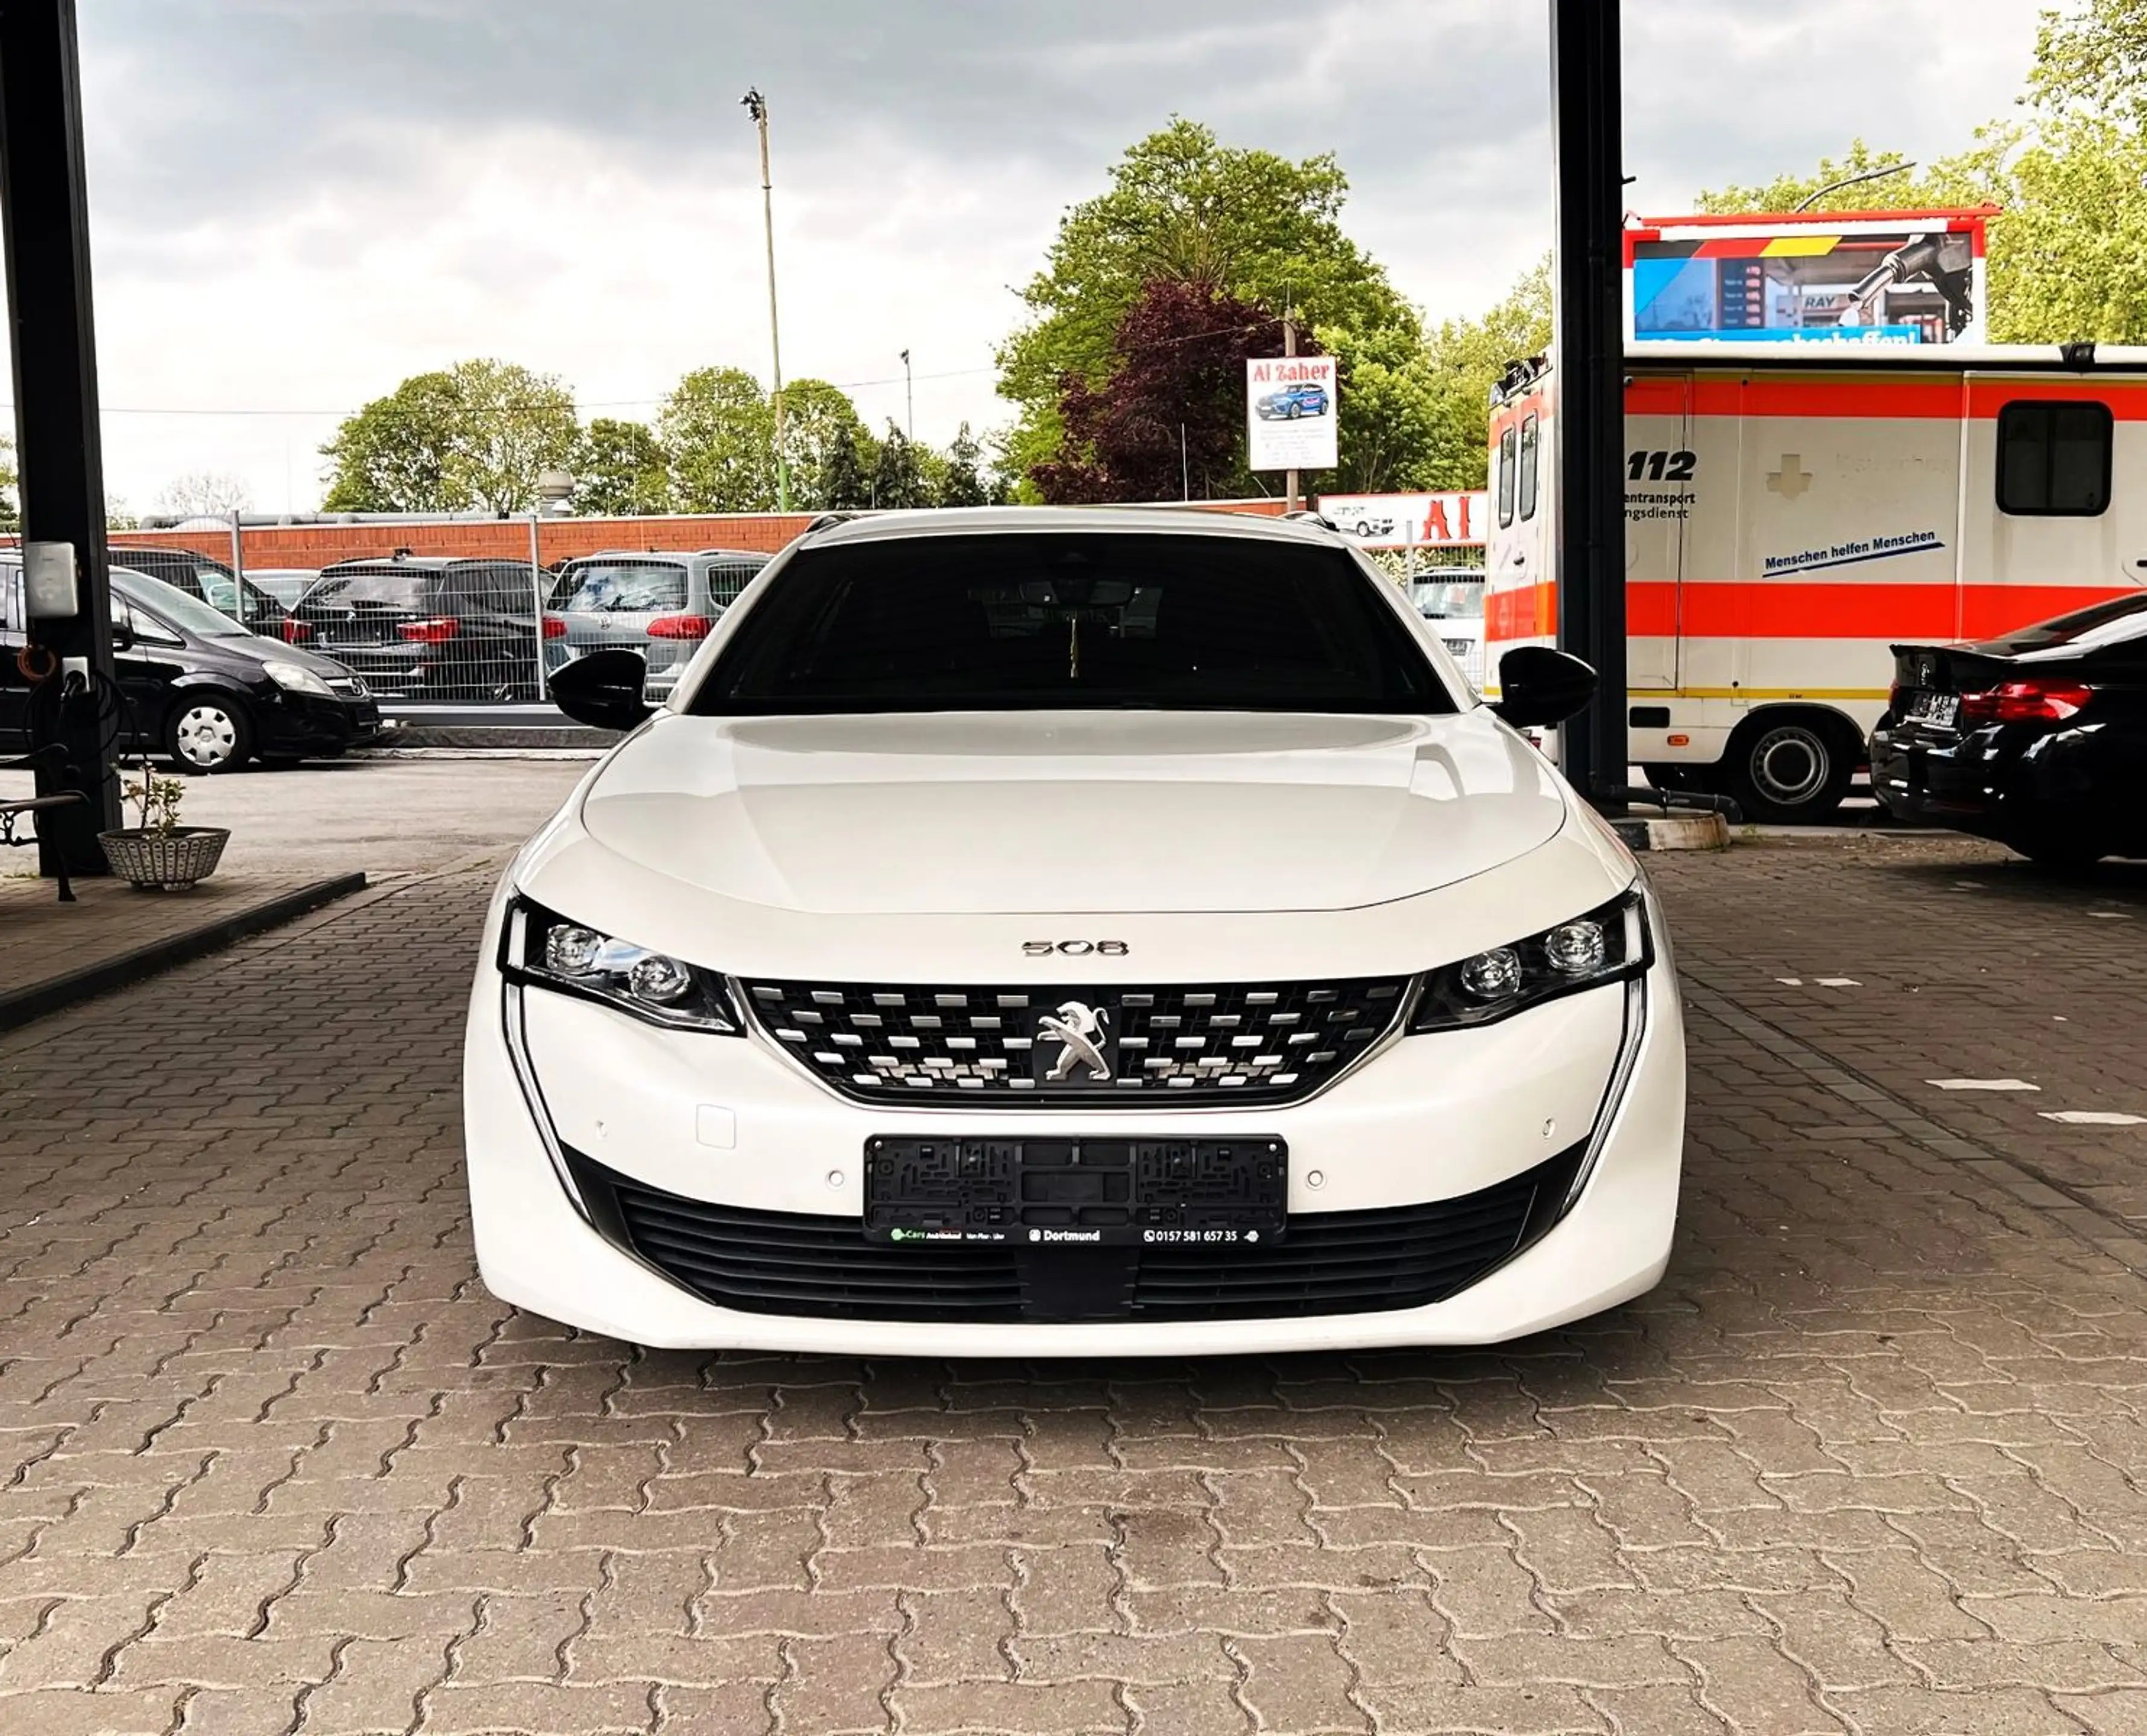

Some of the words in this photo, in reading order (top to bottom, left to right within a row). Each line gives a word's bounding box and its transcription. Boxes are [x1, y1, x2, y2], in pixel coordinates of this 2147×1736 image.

[1275, 362, 1331, 382] Zaher
[1627, 450, 1697, 482] 112
[1419, 495, 1472, 541] Al
[1765, 550, 1829, 570] Menschen
[1830, 542, 1870, 558] helfen
[1873, 530, 1936, 550] Menschen
[1021, 940, 1130, 957] 508
[1043, 1228, 1101, 1242] Dortmund
[1155, 1230, 1182, 1242] 0157
[1183, 1230, 1201, 1242] 581
[1203, 1230, 1223, 1242] 657
[1225, 1230, 1238, 1242] 35
